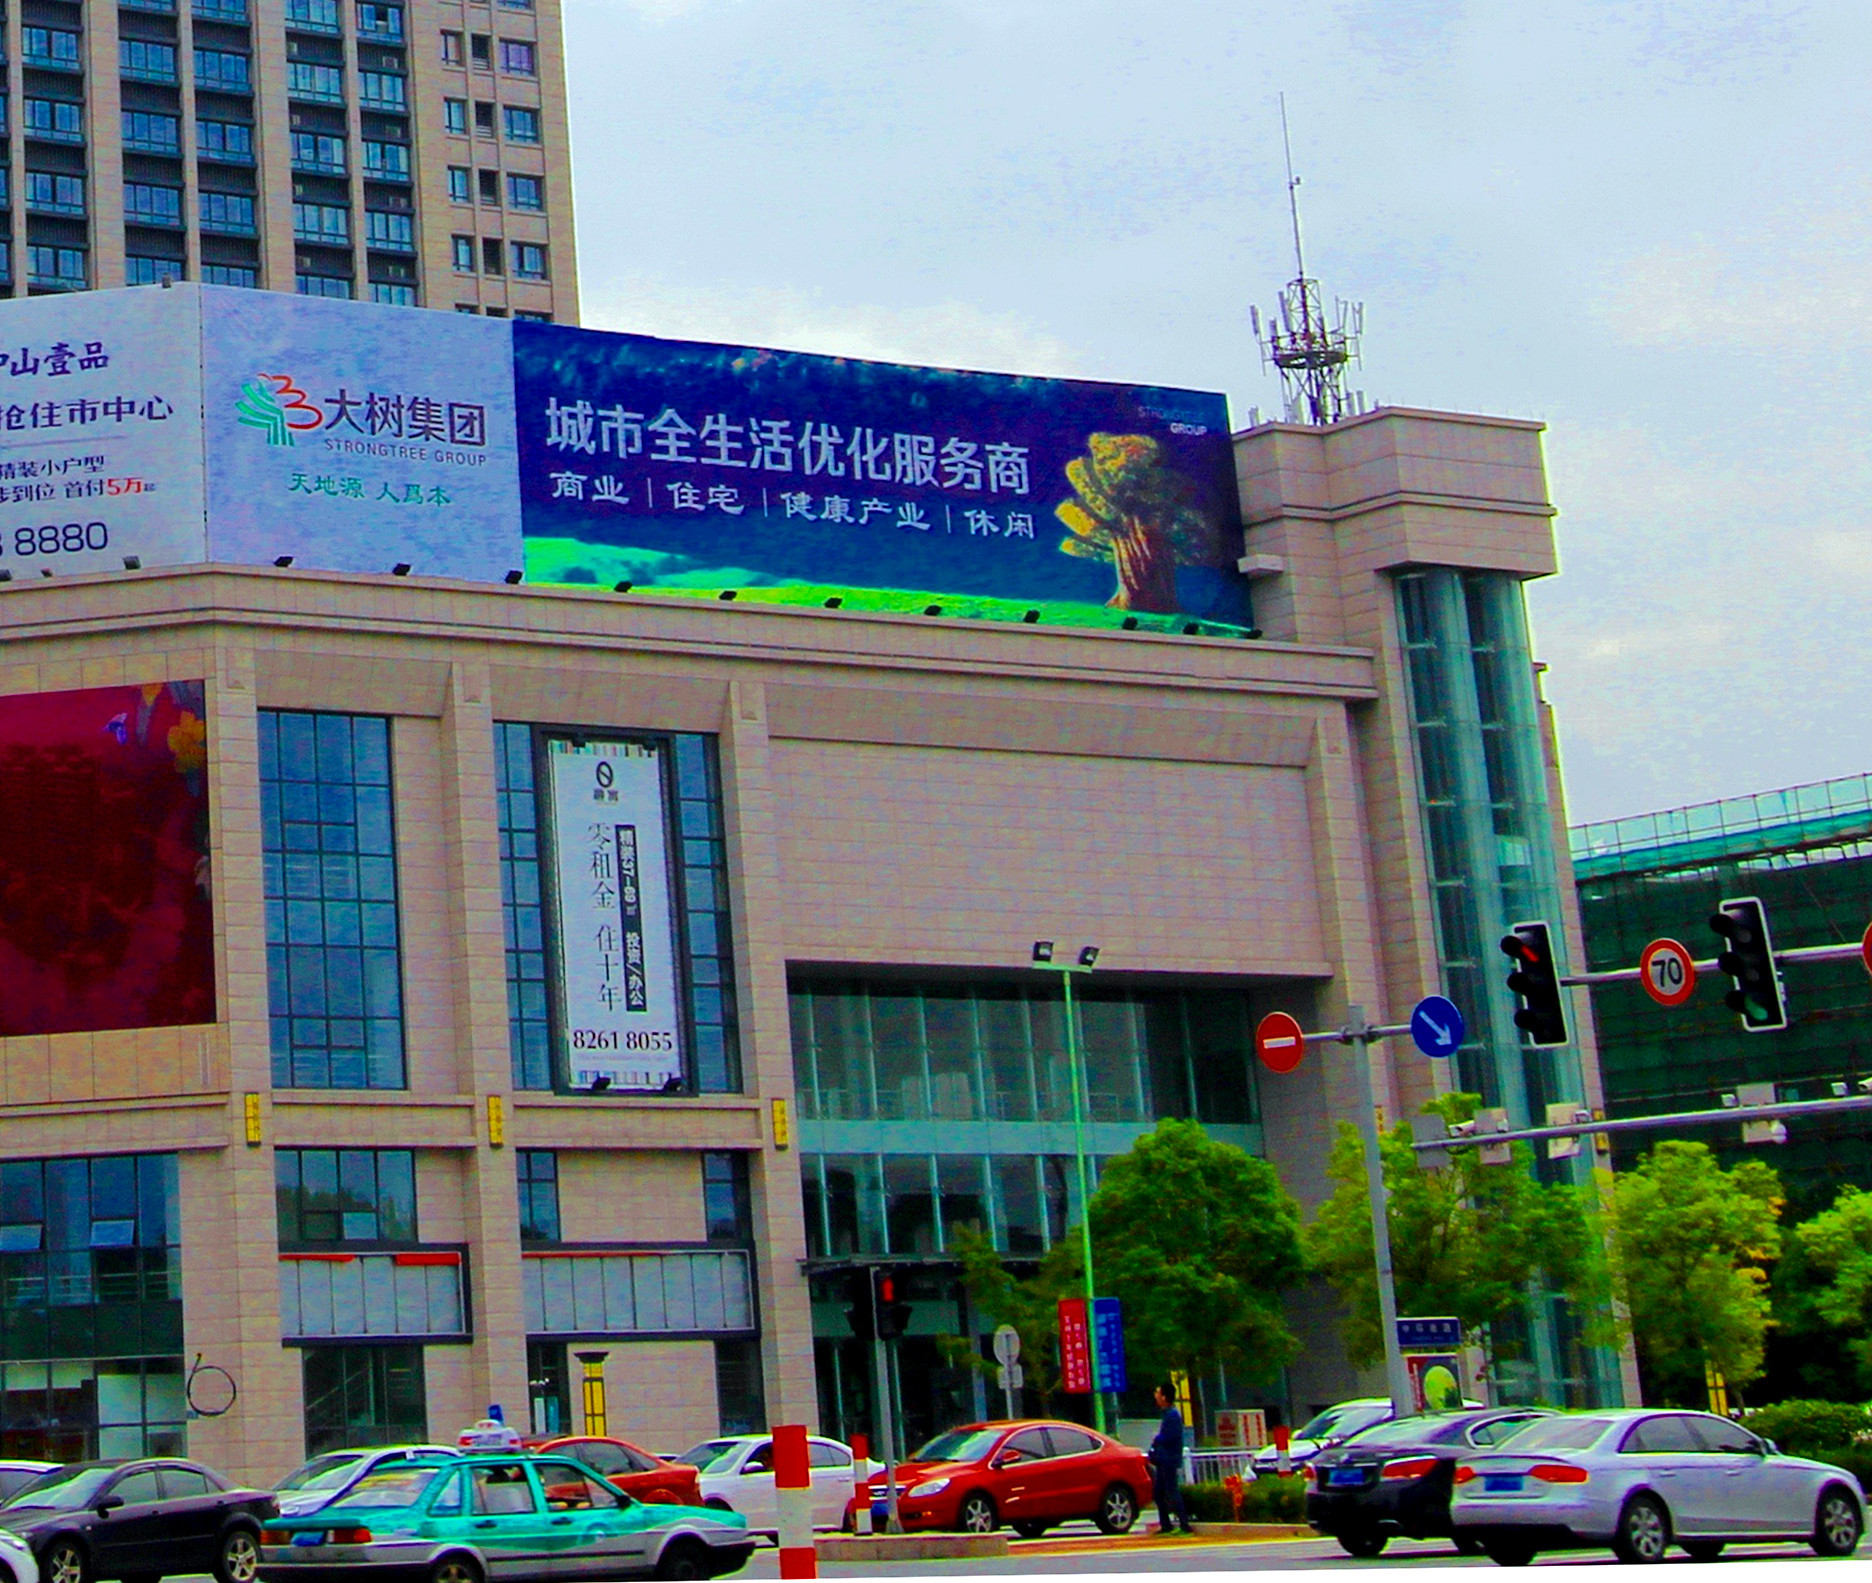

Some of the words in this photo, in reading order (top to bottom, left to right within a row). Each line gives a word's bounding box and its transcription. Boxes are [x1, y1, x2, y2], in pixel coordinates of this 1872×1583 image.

[324, 389, 486, 446] 大树集团
[325, 439, 427, 461] STRONGTREE
[435, 449, 487, 466] GROUP
[545, 397, 1029, 494] 城市全生活优化服务商
[289, 472, 365, 498] 天地源
[549, 471, 630, 504] 商业
[667, 482, 744, 515] 住宅
[780, 491, 930, 530] 健康产业
[964, 509, 1034, 539] 休闲
[14, 521, 109, 556] 8880
[588, 822, 616, 909] 零租金
[594, 925, 623, 1011] 住十年
[1651, 957, 1683, 987] 70
[573, 1029, 618, 1050] 8261
[626, 1030, 673, 1052] 8055
